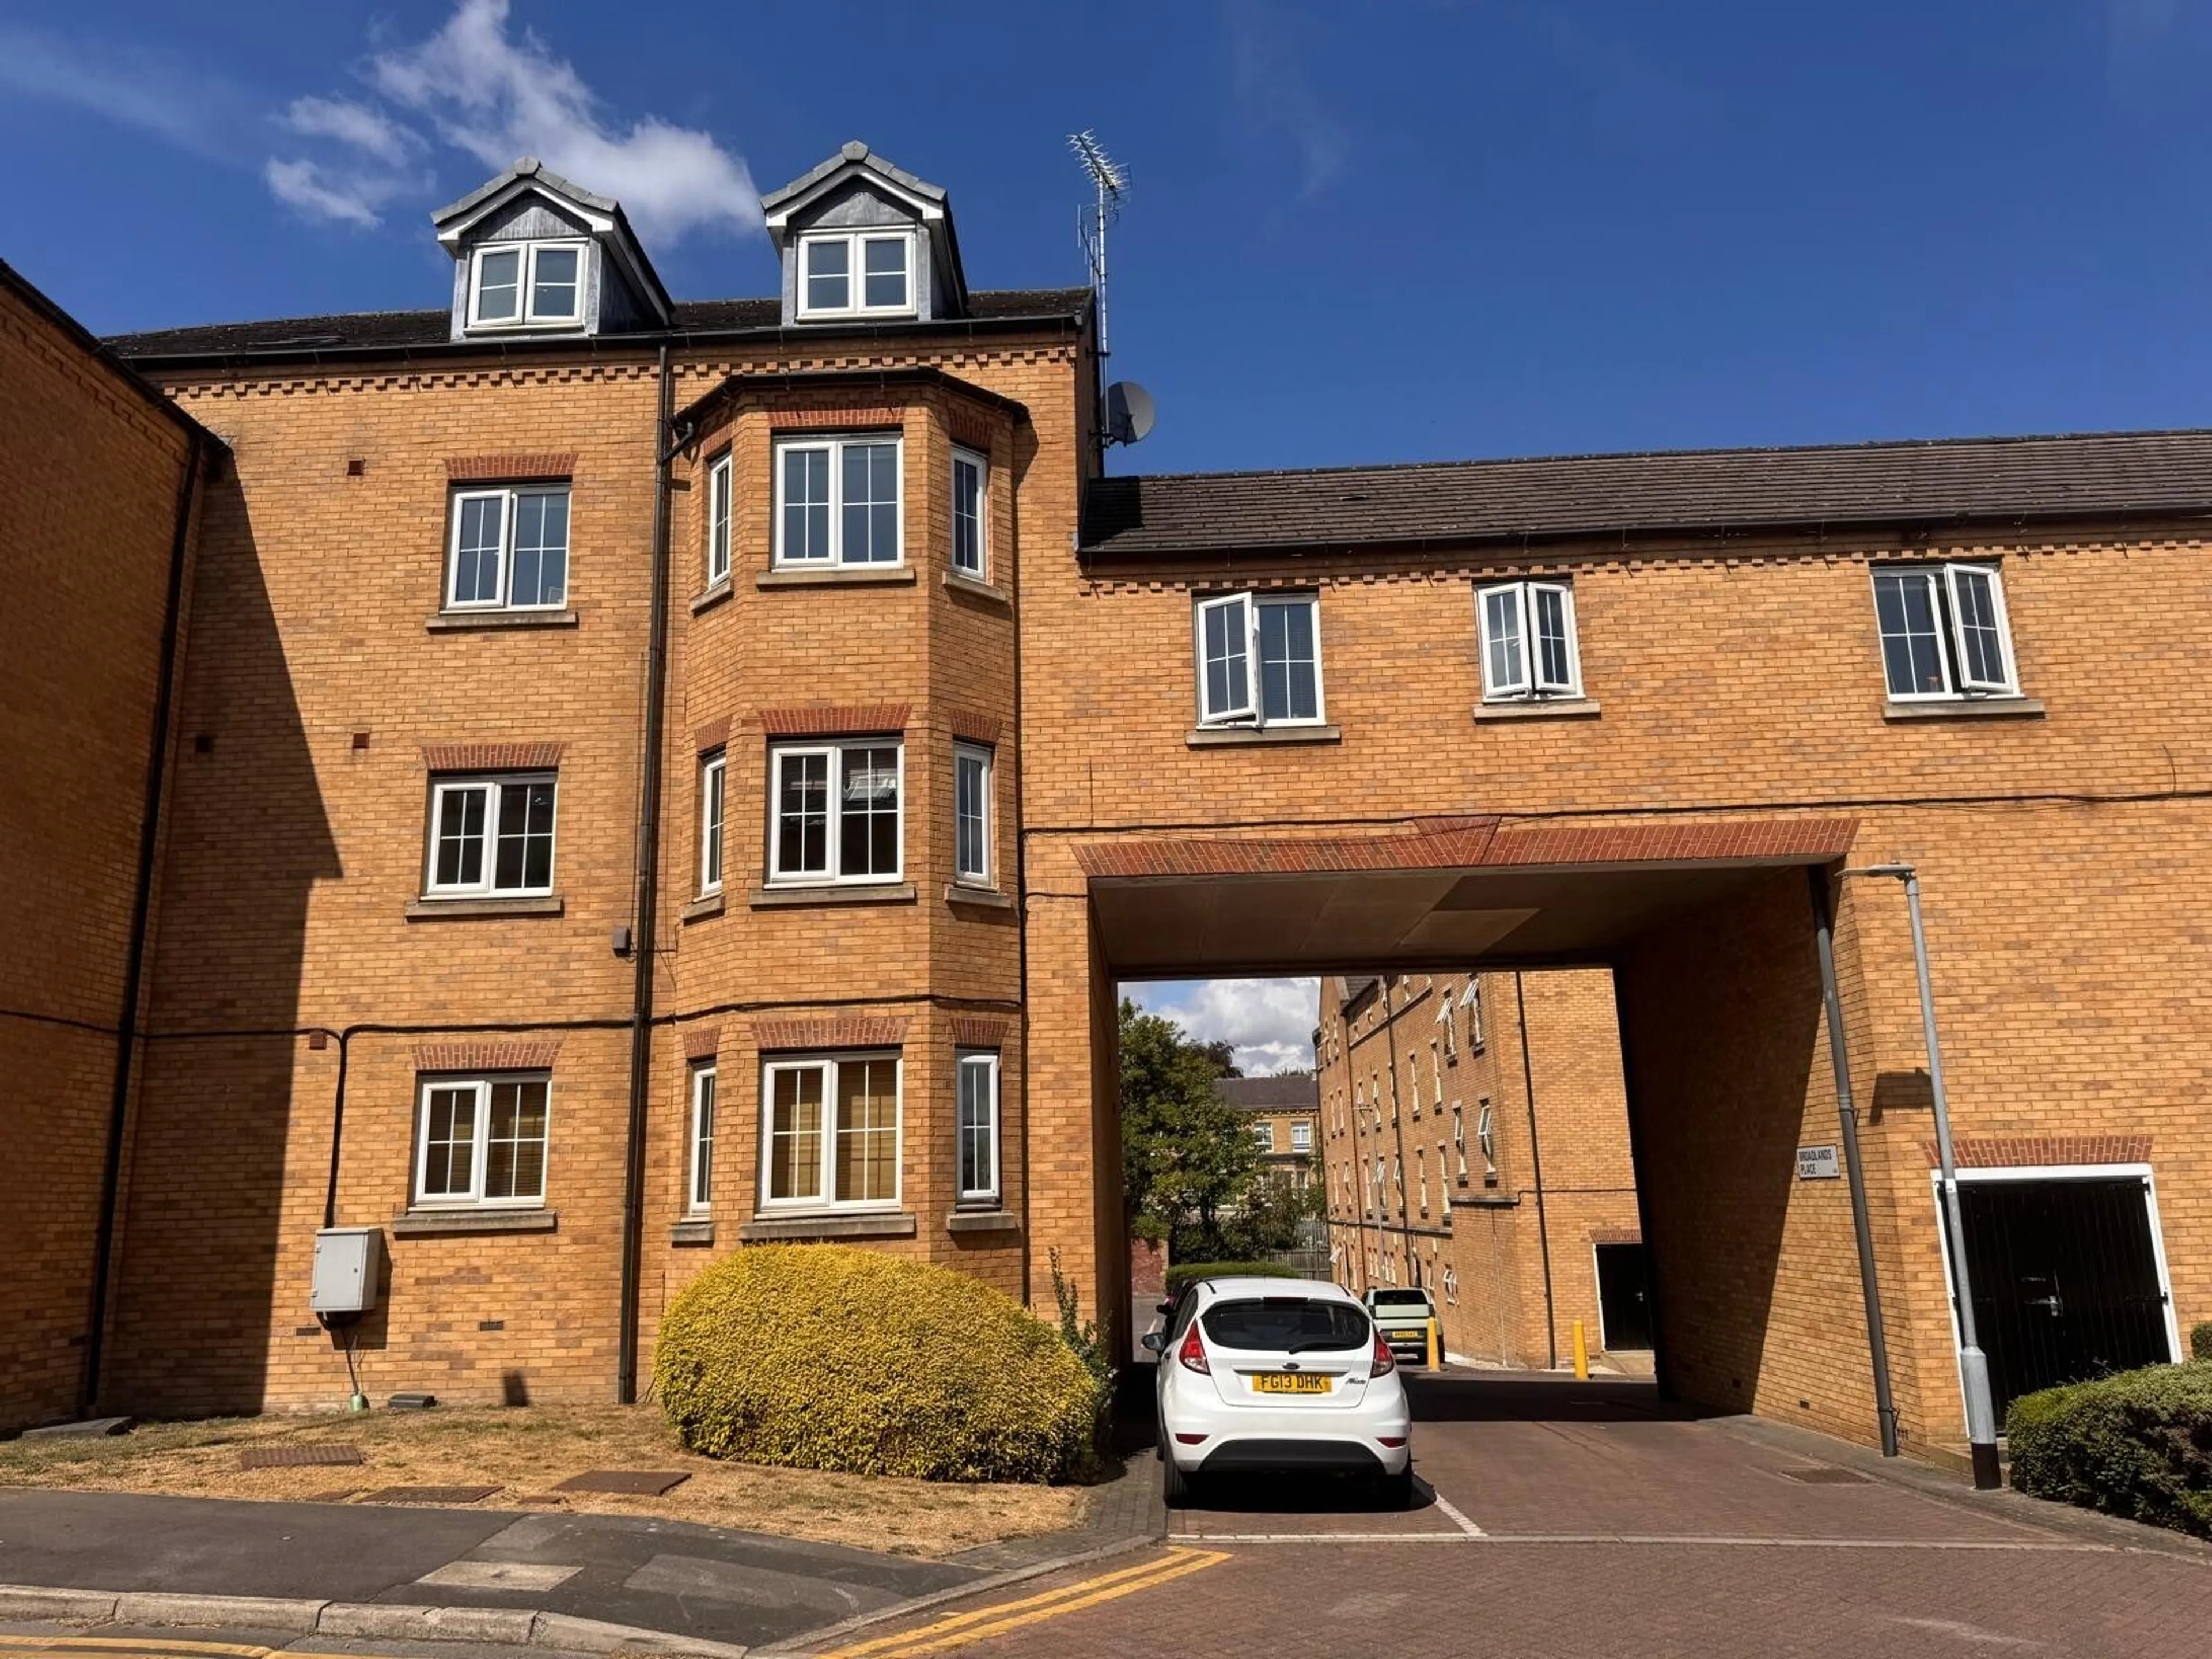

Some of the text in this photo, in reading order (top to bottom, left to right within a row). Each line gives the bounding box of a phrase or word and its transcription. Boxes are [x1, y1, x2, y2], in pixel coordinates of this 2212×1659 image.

[1798, 1149, 1832, 1162] BROADLANDS
[1800, 1164, 1816, 1175] PLACE
[1261, 1374, 1323, 1389] FG13 DHK
